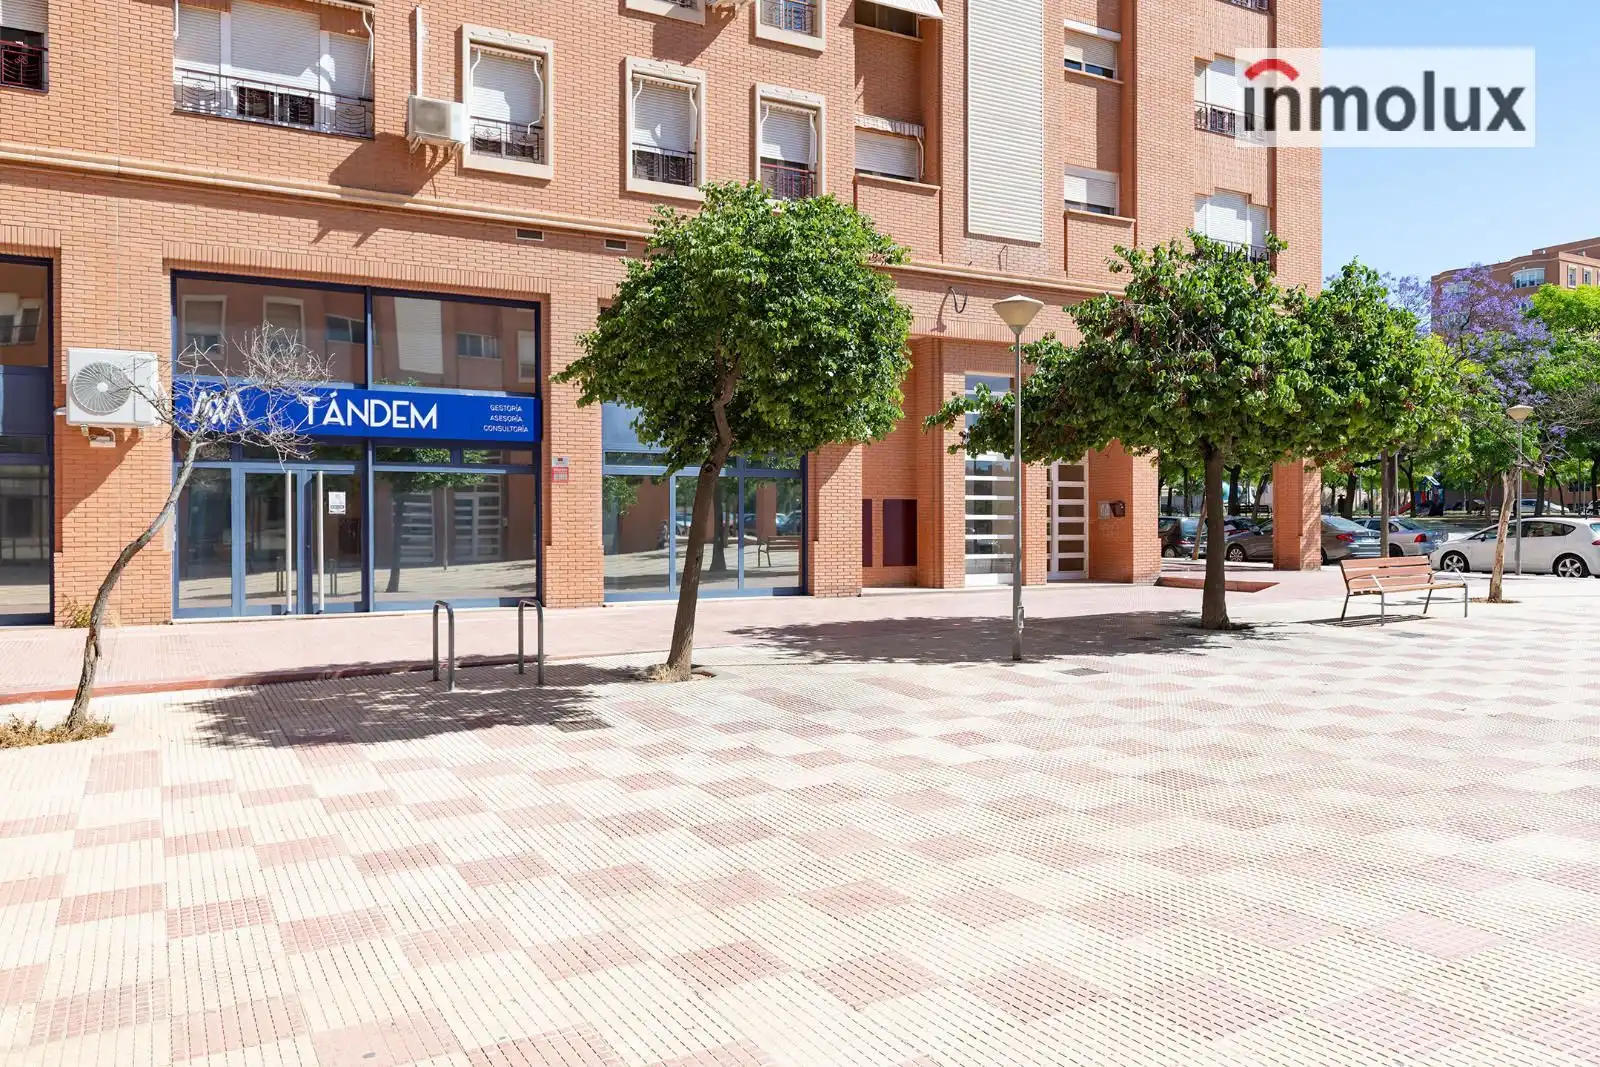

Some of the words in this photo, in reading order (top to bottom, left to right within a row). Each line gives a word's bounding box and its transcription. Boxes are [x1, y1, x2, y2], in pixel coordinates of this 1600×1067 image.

[301, 390, 438, 430] TÁNDEM
[489, 403, 523, 412] GESTORÍA
[489, 414, 524, 422] ASESORÍA
[482, 424, 529, 433] CONSULTORÍA
